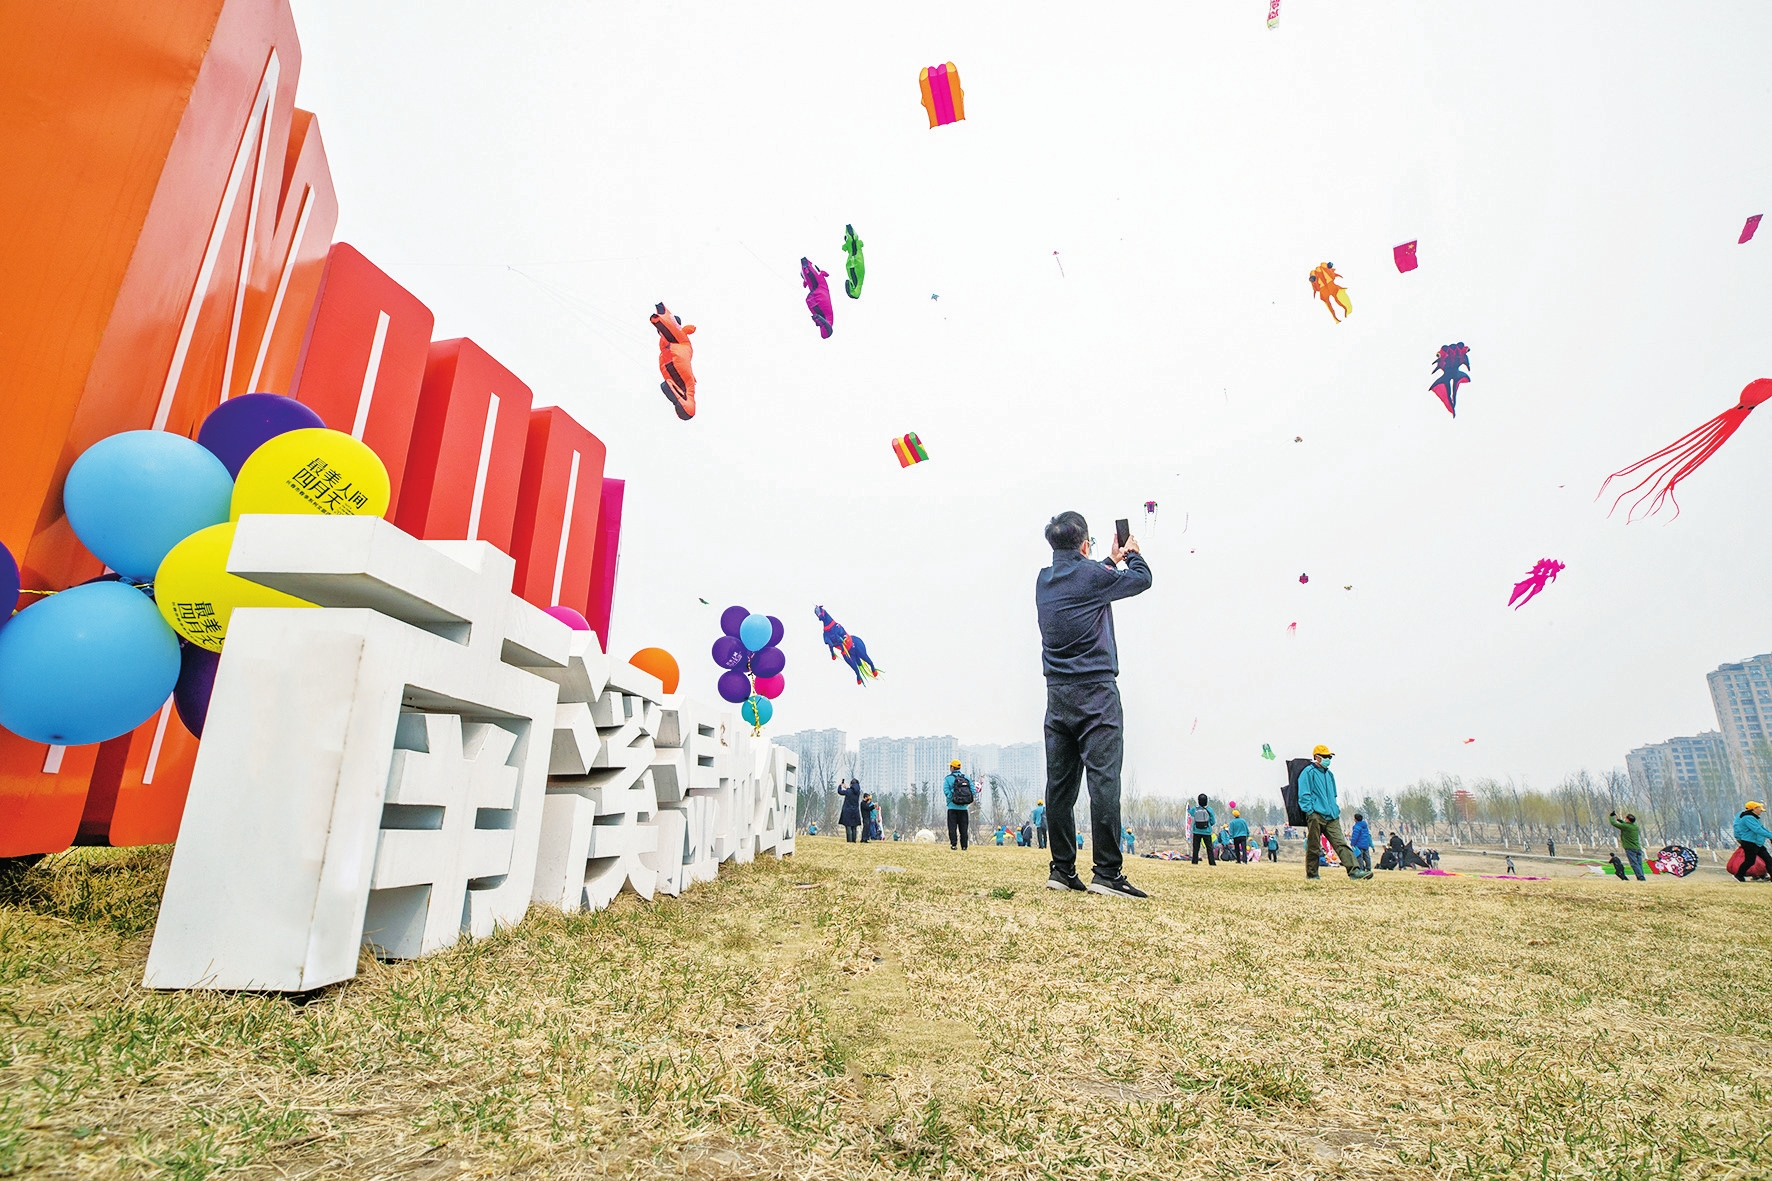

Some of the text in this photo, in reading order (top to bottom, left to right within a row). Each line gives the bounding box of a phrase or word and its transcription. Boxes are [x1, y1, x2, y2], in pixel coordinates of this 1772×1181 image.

[292, 467, 344, 511] 四月天
[306, 457, 369, 510] 最美人间
[177, 603, 217, 646] 四月天
